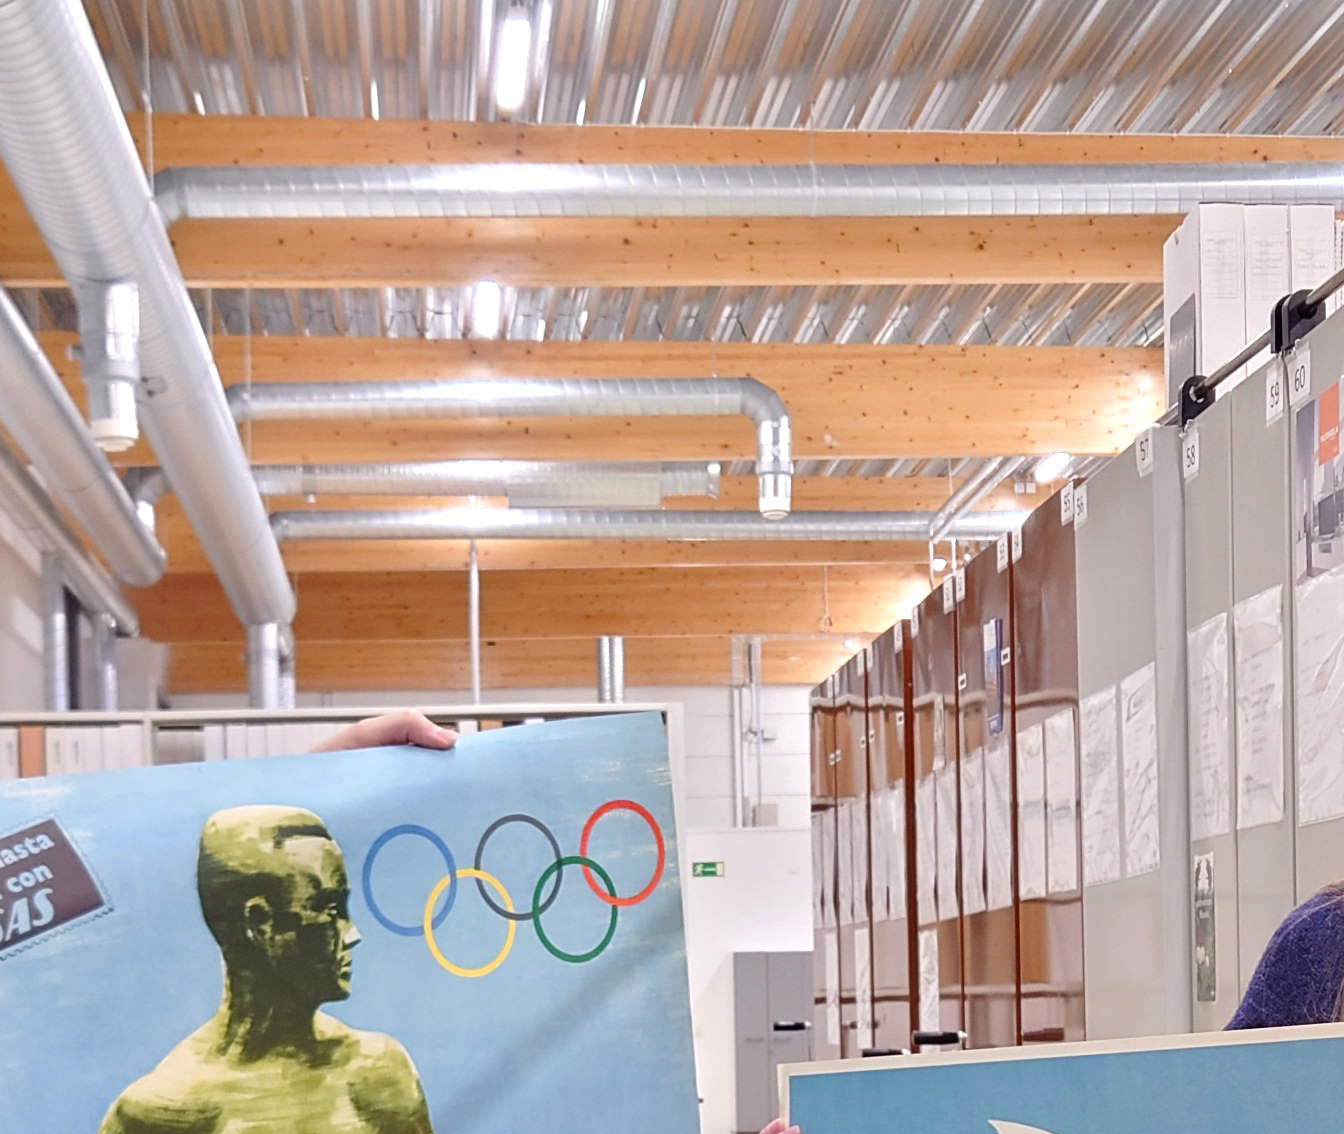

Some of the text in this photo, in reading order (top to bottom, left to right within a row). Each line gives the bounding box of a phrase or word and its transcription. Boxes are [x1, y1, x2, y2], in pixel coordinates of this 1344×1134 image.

[1294, 363, 1305, 392] 60
[1270, 381, 1280, 409] 59
[1139, 437, 1149, 462] 57
[1186, 444, 1196, 469] 58
[7, 863, 54, 894] con
